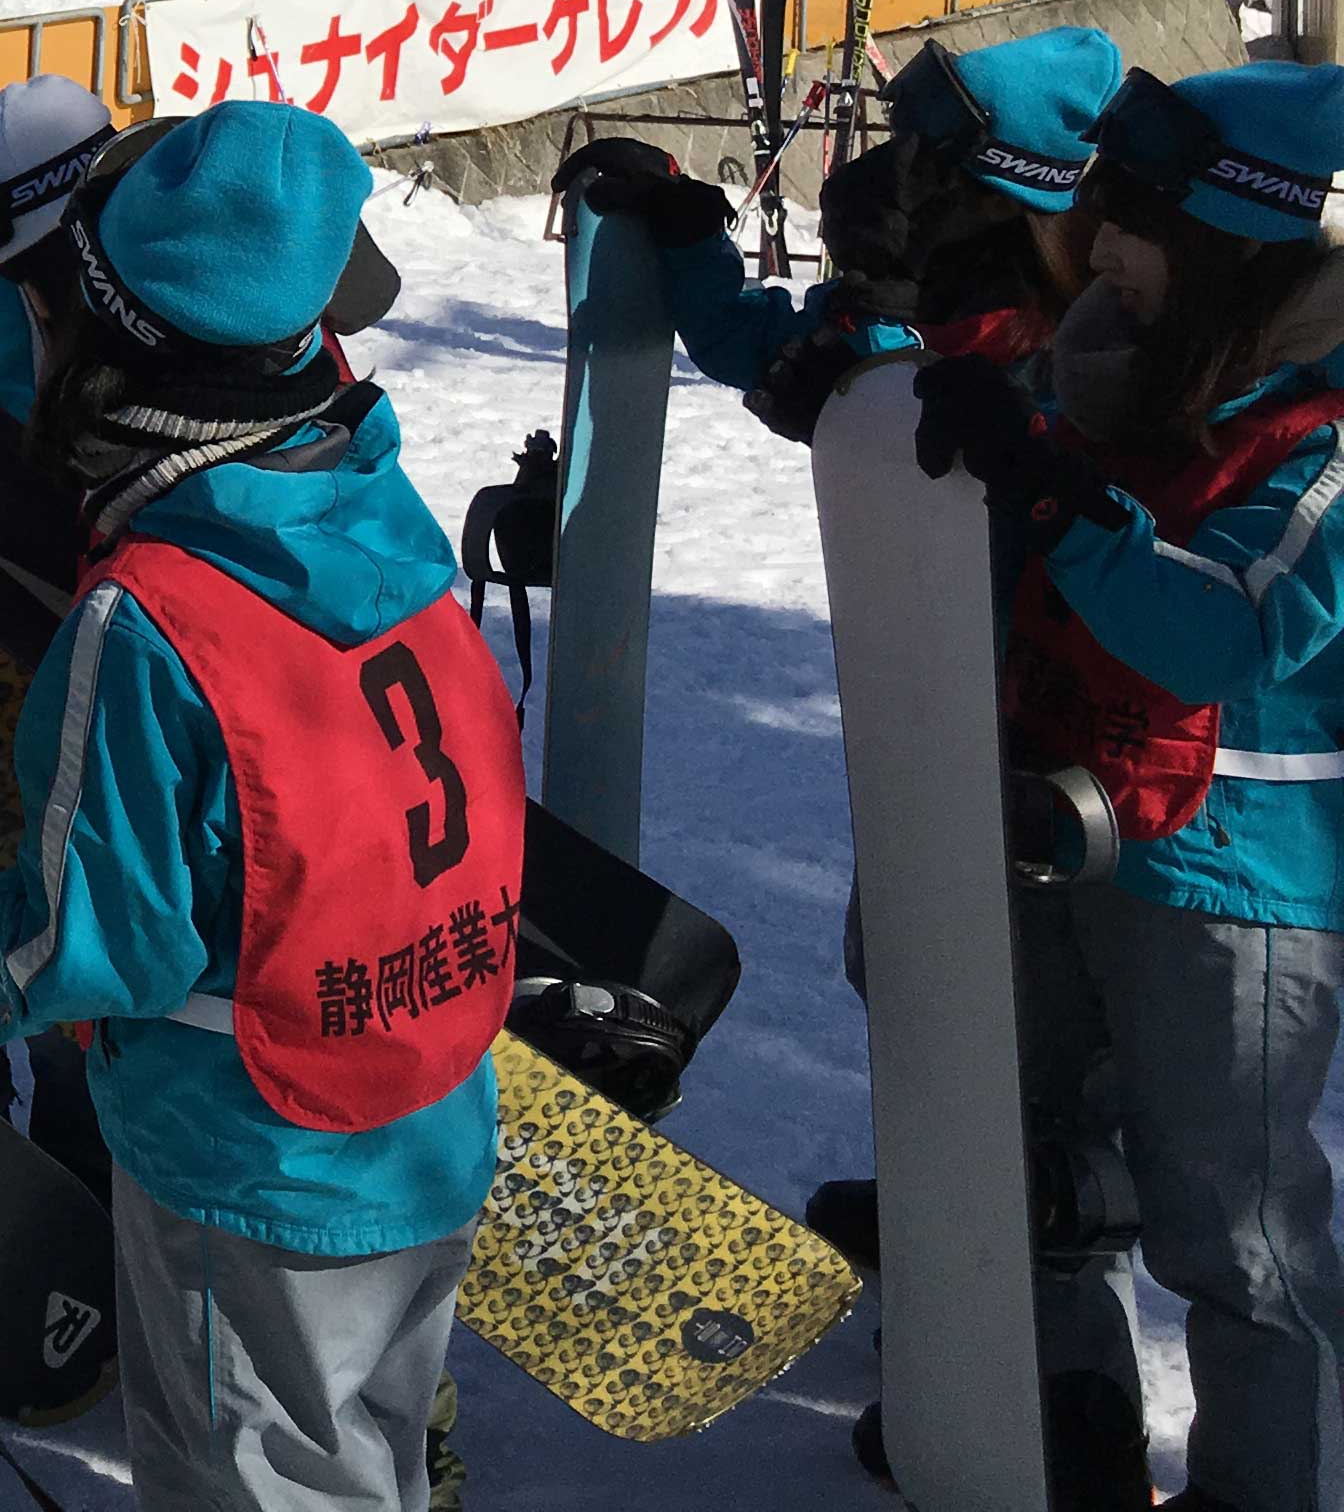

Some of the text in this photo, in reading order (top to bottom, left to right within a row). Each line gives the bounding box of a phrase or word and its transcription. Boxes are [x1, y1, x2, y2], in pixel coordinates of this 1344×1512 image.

[978, 147, 1080, 185] SWANS
[1208, 159, 1326, 209] SWANS
[70, 219, 166, 347] SWANS
[360, 640, 470, 888] 3
